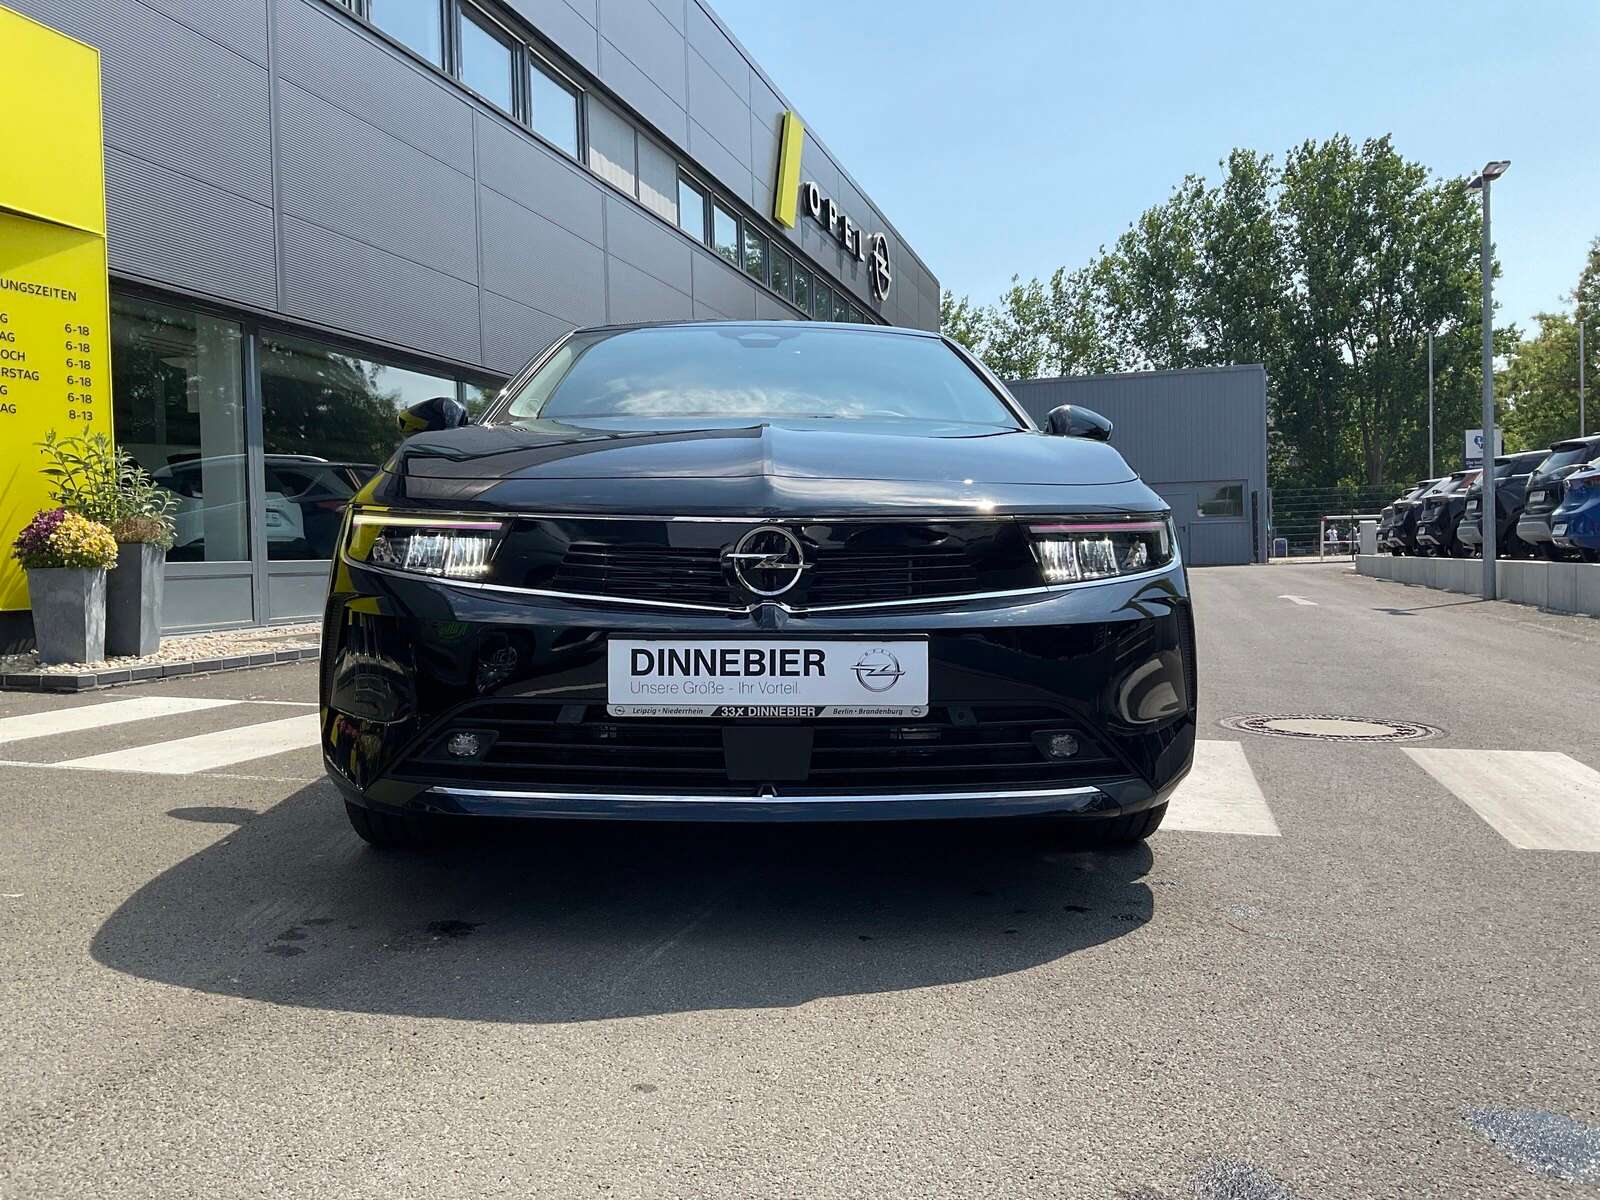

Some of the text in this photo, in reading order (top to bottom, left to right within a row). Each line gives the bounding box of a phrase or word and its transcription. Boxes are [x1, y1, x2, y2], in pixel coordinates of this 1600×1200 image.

[803, 181, 865, 262] OPEL
[64, 323, 90, 336] 6-18
[65, 340, 90, 353] 6-18
[66, 358, 91, 370] 6-18
[67, 375, 92, 387] 6-18
[67, 392, 92, 404] 6-18
[68, 409, 93, 421] 8-13
[630, 649, 826, 677] DINNEBIER
[630, 681, 679, 695] Unsere
[683, 681, 725, 695] Größe
[738, 681, 754, 694] Ihr
[758, 681, 801, 695] Vorteil.
[632, 707, 704, 716] Leipzig Niederrhein
[748, 707, 816, 717] DINNEBIER
[833, 707, 904, 716] Berlin Brandenburg
